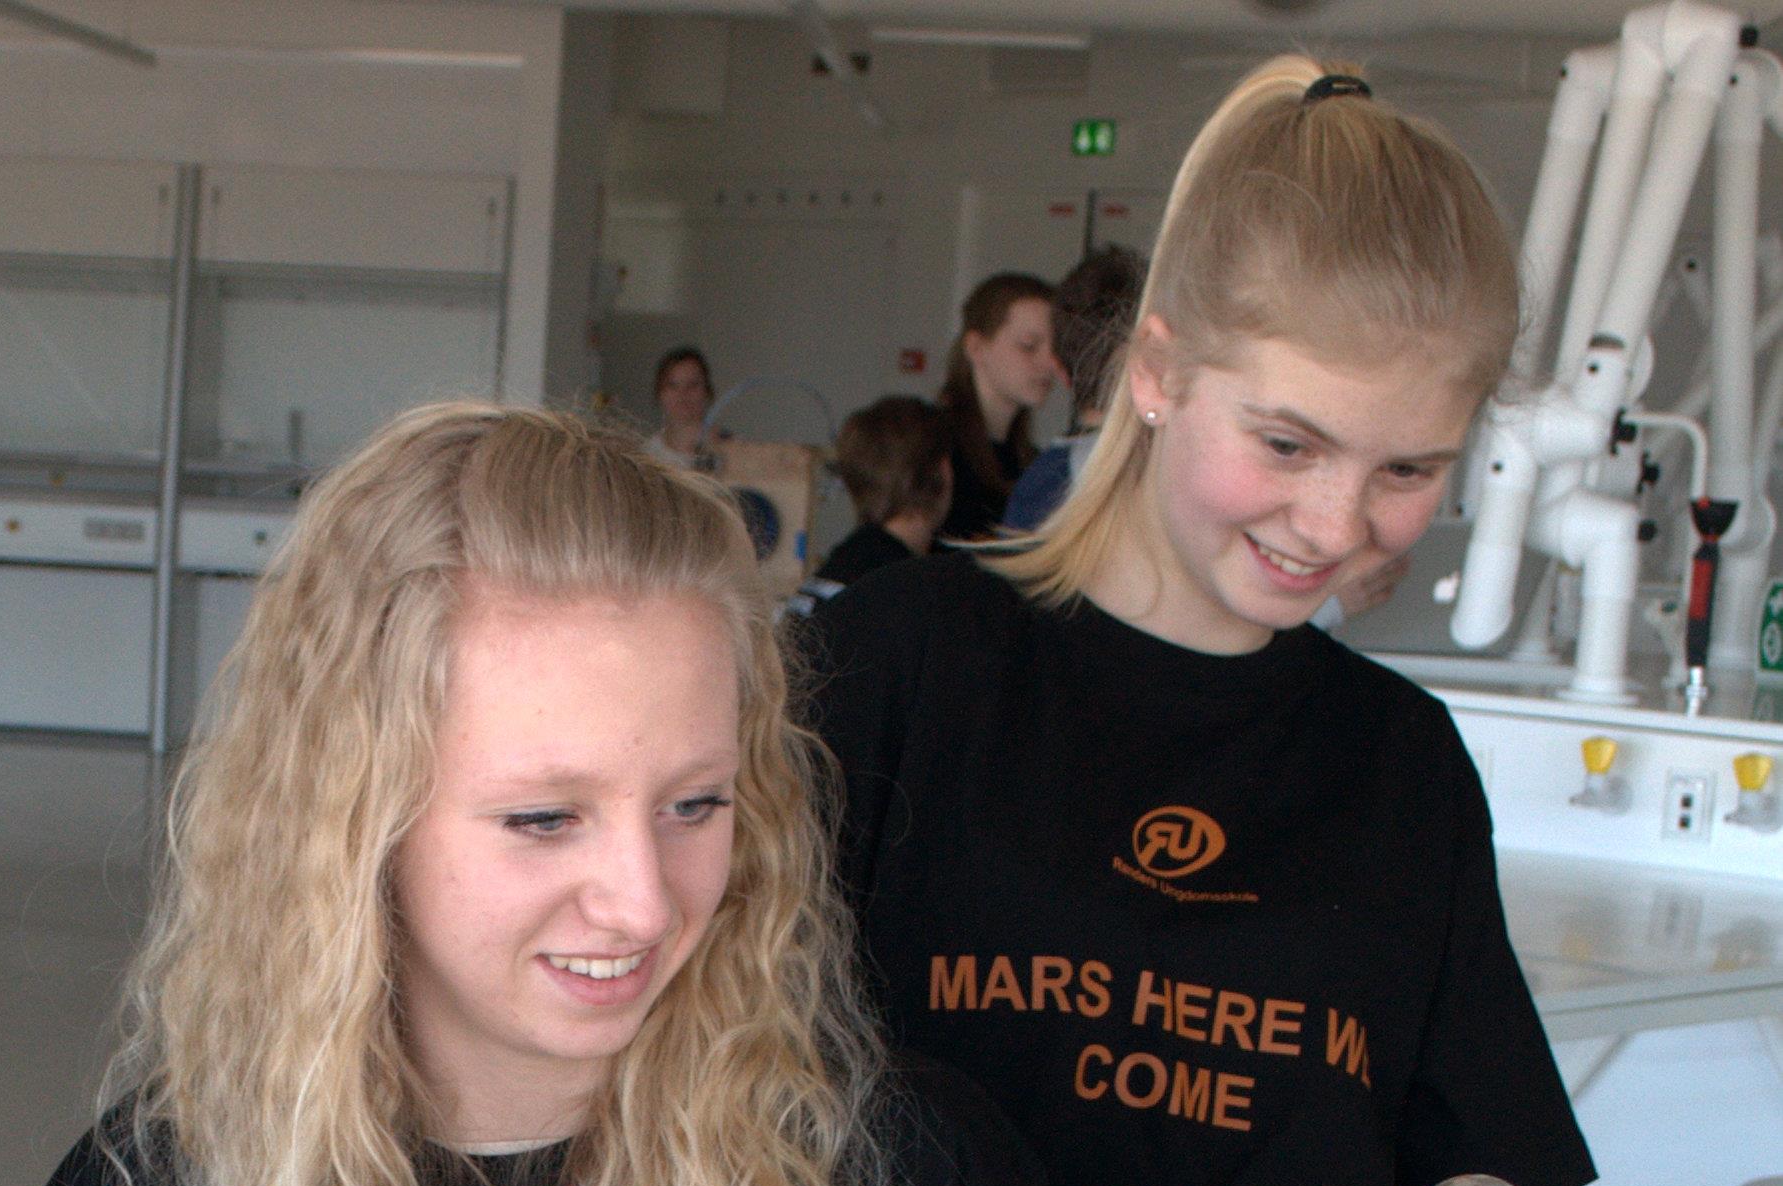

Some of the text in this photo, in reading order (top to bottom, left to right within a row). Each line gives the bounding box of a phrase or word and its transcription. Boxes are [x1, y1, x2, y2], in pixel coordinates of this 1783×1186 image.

[928, 955, 1372, 1090] MARS HERE W
[1075, 1044, 1255, 1132] COME
